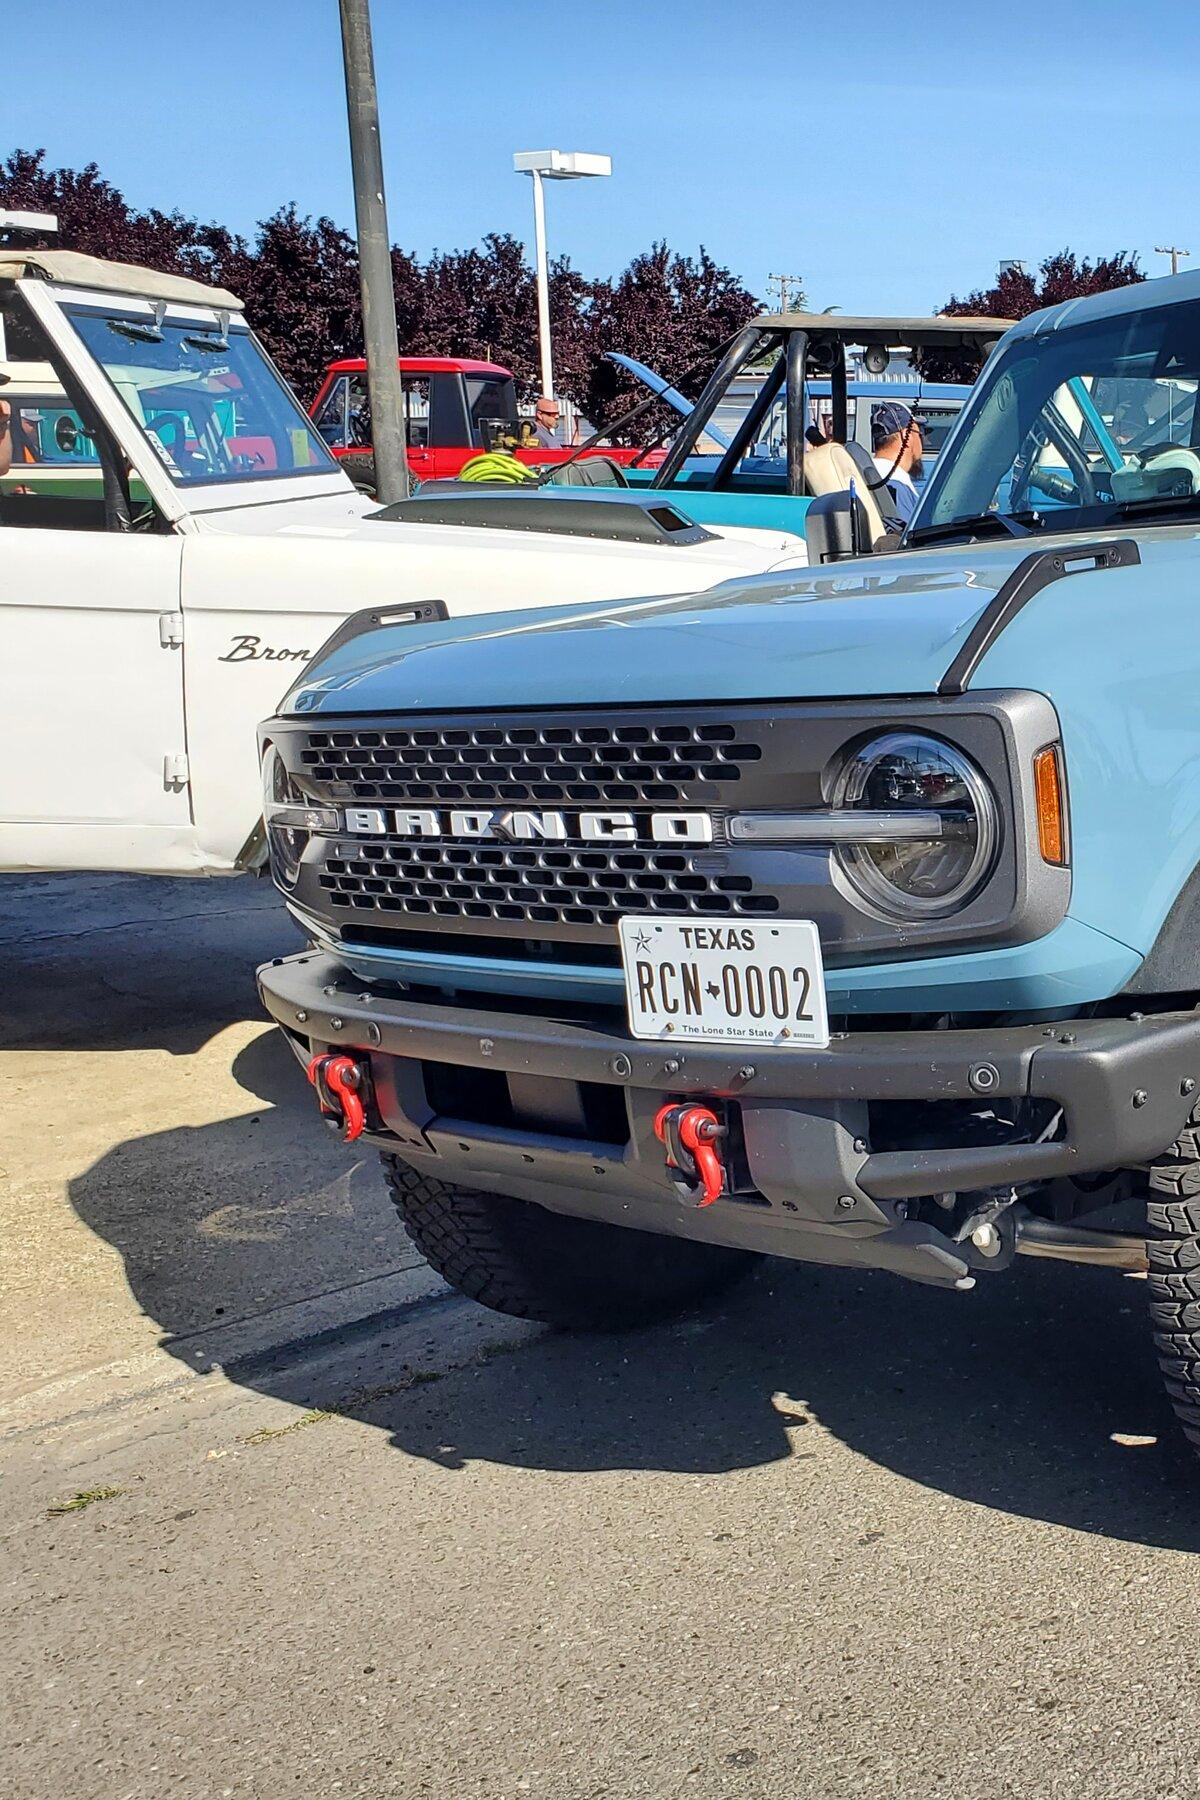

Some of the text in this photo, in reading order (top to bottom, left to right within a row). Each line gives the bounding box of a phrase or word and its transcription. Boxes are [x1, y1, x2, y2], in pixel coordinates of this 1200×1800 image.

[217, 635, 313, 662] Bron
[345, 808, 713, 843] BRONCO
[679, 927, 756, 951] TEXAS
[636, 961, 813, 1021] RCN 0002
[682, 1025, 774, 1037] The Lone Star State
